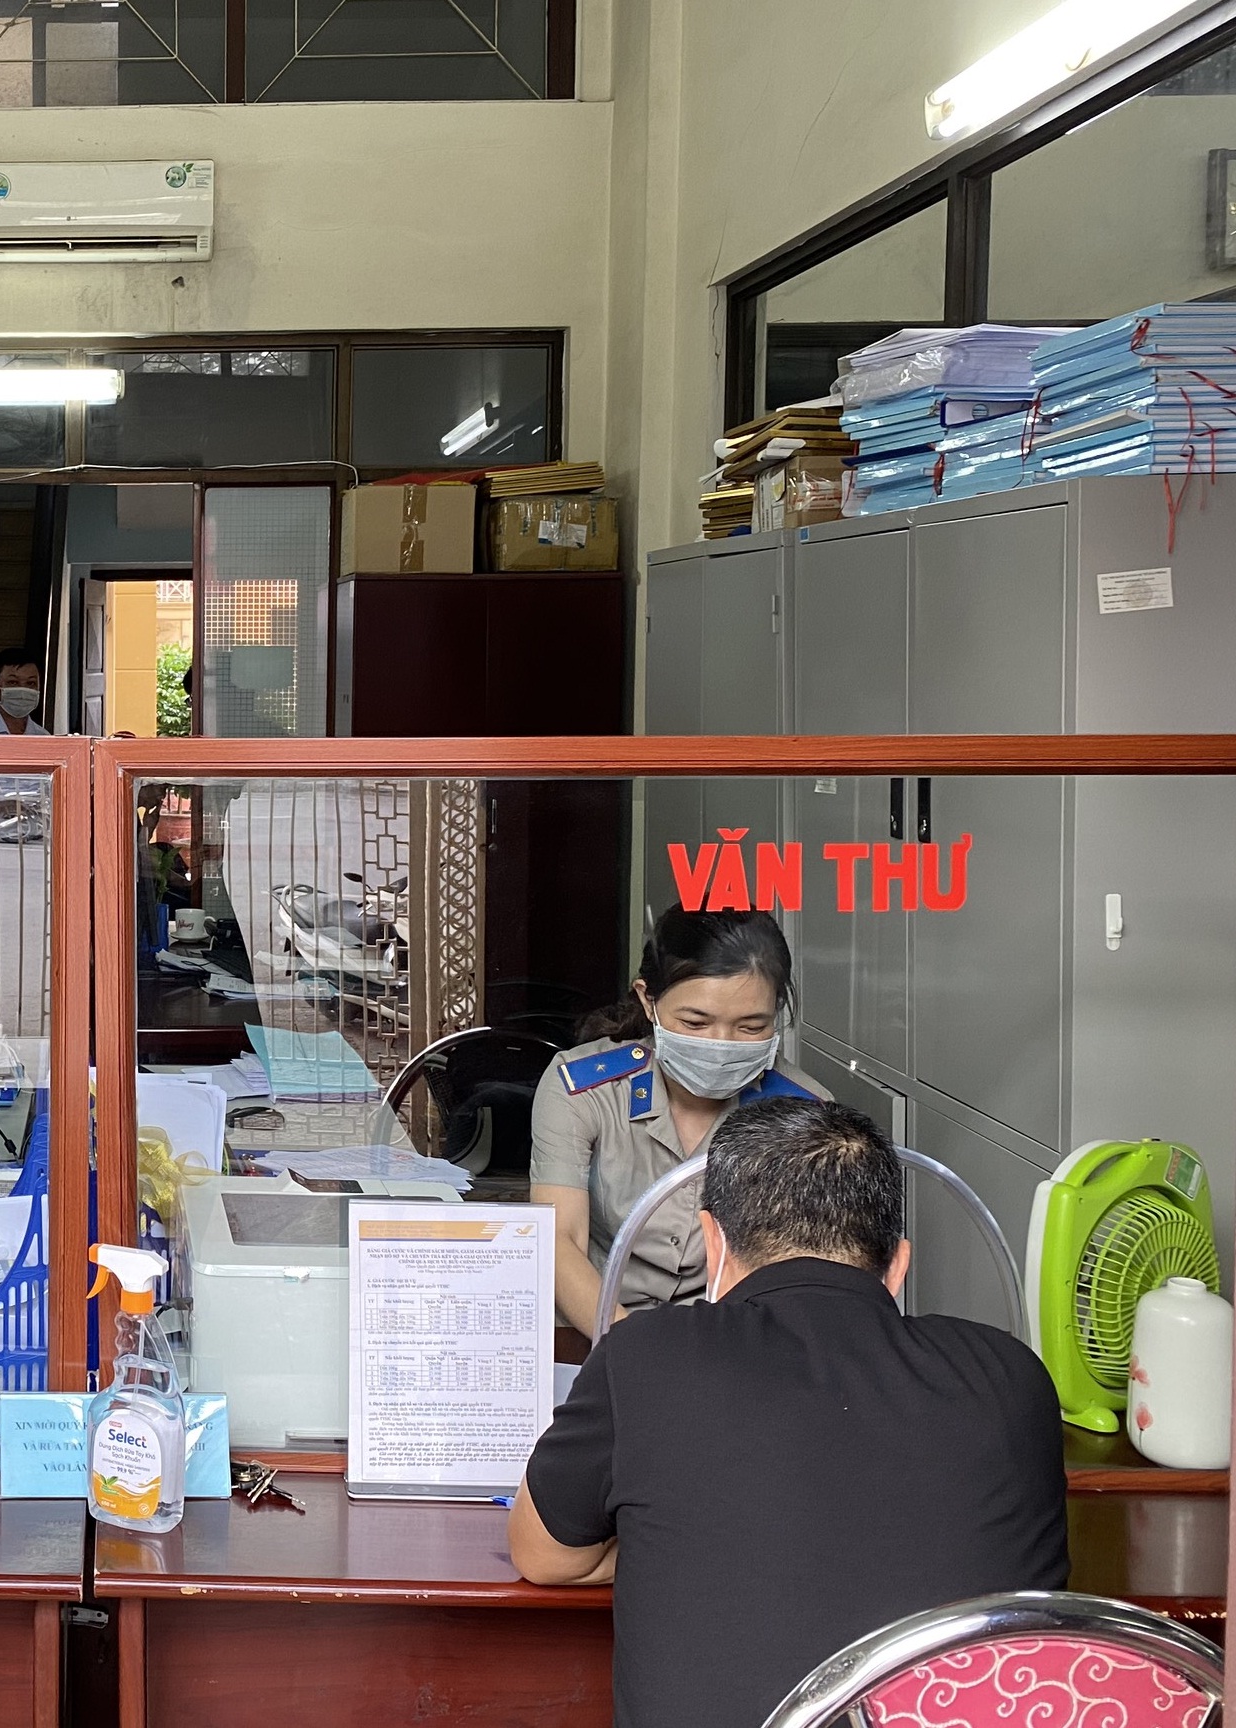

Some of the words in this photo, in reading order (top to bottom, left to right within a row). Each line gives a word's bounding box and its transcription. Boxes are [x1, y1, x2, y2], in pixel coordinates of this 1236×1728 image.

[667, 827, 803, 912] VĂN
[823, 833, 973, 912] THƯ
[14, 1422, 32, 1430] XIN
[34, 1419, 56, 1430] MỜI
[58, 1420, 80, 1432] QUÝ
[108, 1428, 147, 1448] Select
[23, 1440, 38, 1451] VÀ
[40, 1440, 62, 1451] RỬA
[64, 1442, 85, 1451] TAY
[43, 1462, 66, 1472] VÀO
